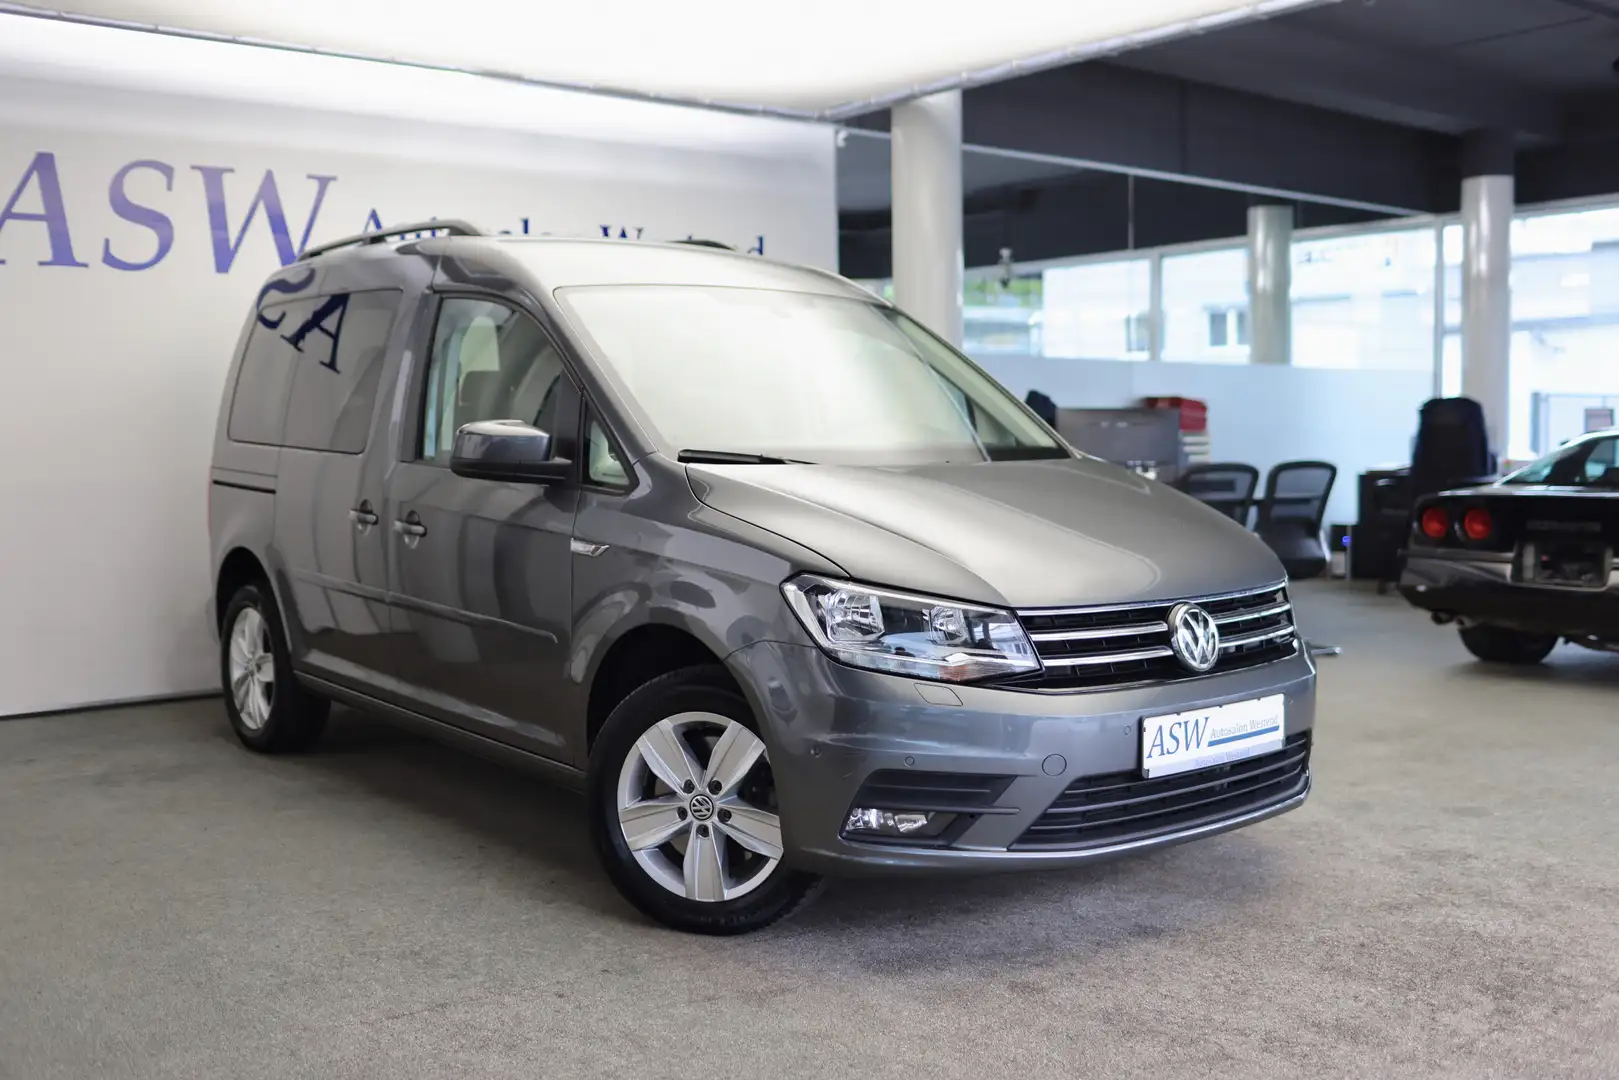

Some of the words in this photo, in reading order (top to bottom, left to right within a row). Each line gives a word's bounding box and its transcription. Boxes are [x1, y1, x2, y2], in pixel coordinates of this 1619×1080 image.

[0, 151, 338, 274] ASW
[1146, 717, 1210, 759] ASW
[1210, 723, 1249, 739] Autosalon
[1249, 714, 1279, 730] Westend
